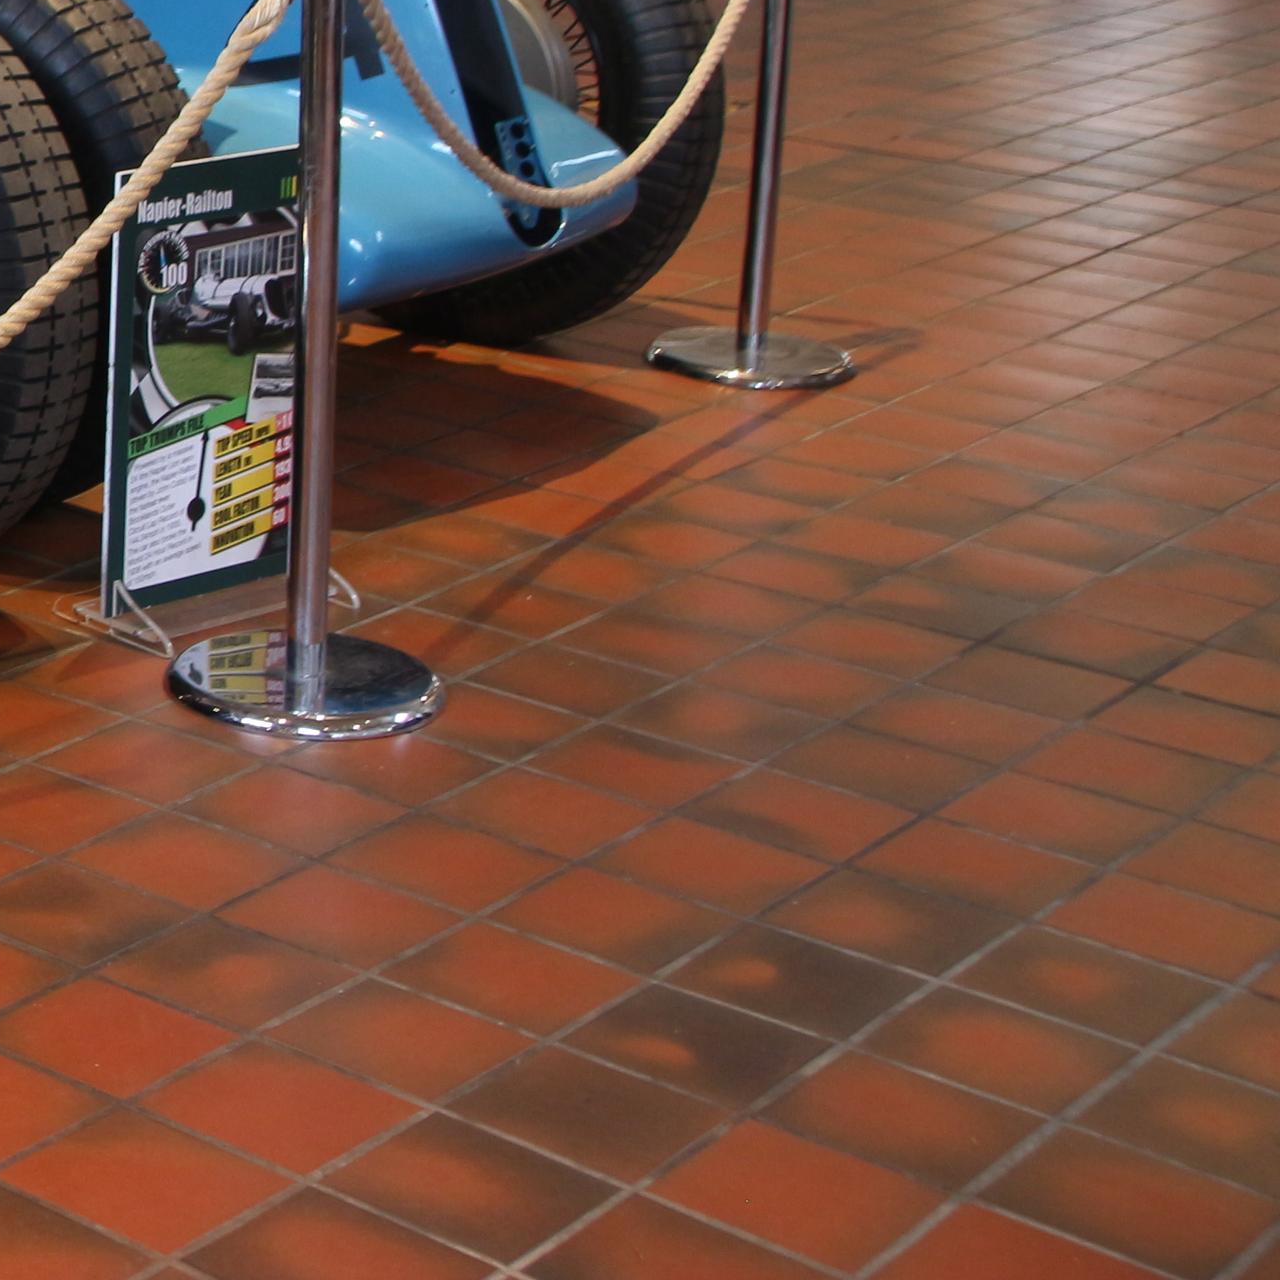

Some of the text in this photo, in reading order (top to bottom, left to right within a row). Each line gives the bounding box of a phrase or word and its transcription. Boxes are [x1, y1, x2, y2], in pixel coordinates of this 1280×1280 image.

[138, 190, 233, 223] Napier-Railton
[160, 262, 188, 288] 100
[130, 415, 204, 455] TOP TRUMPS FILE
[216, 437, 230, 454] TOP
[215, 483, 231, 501] YEAR
